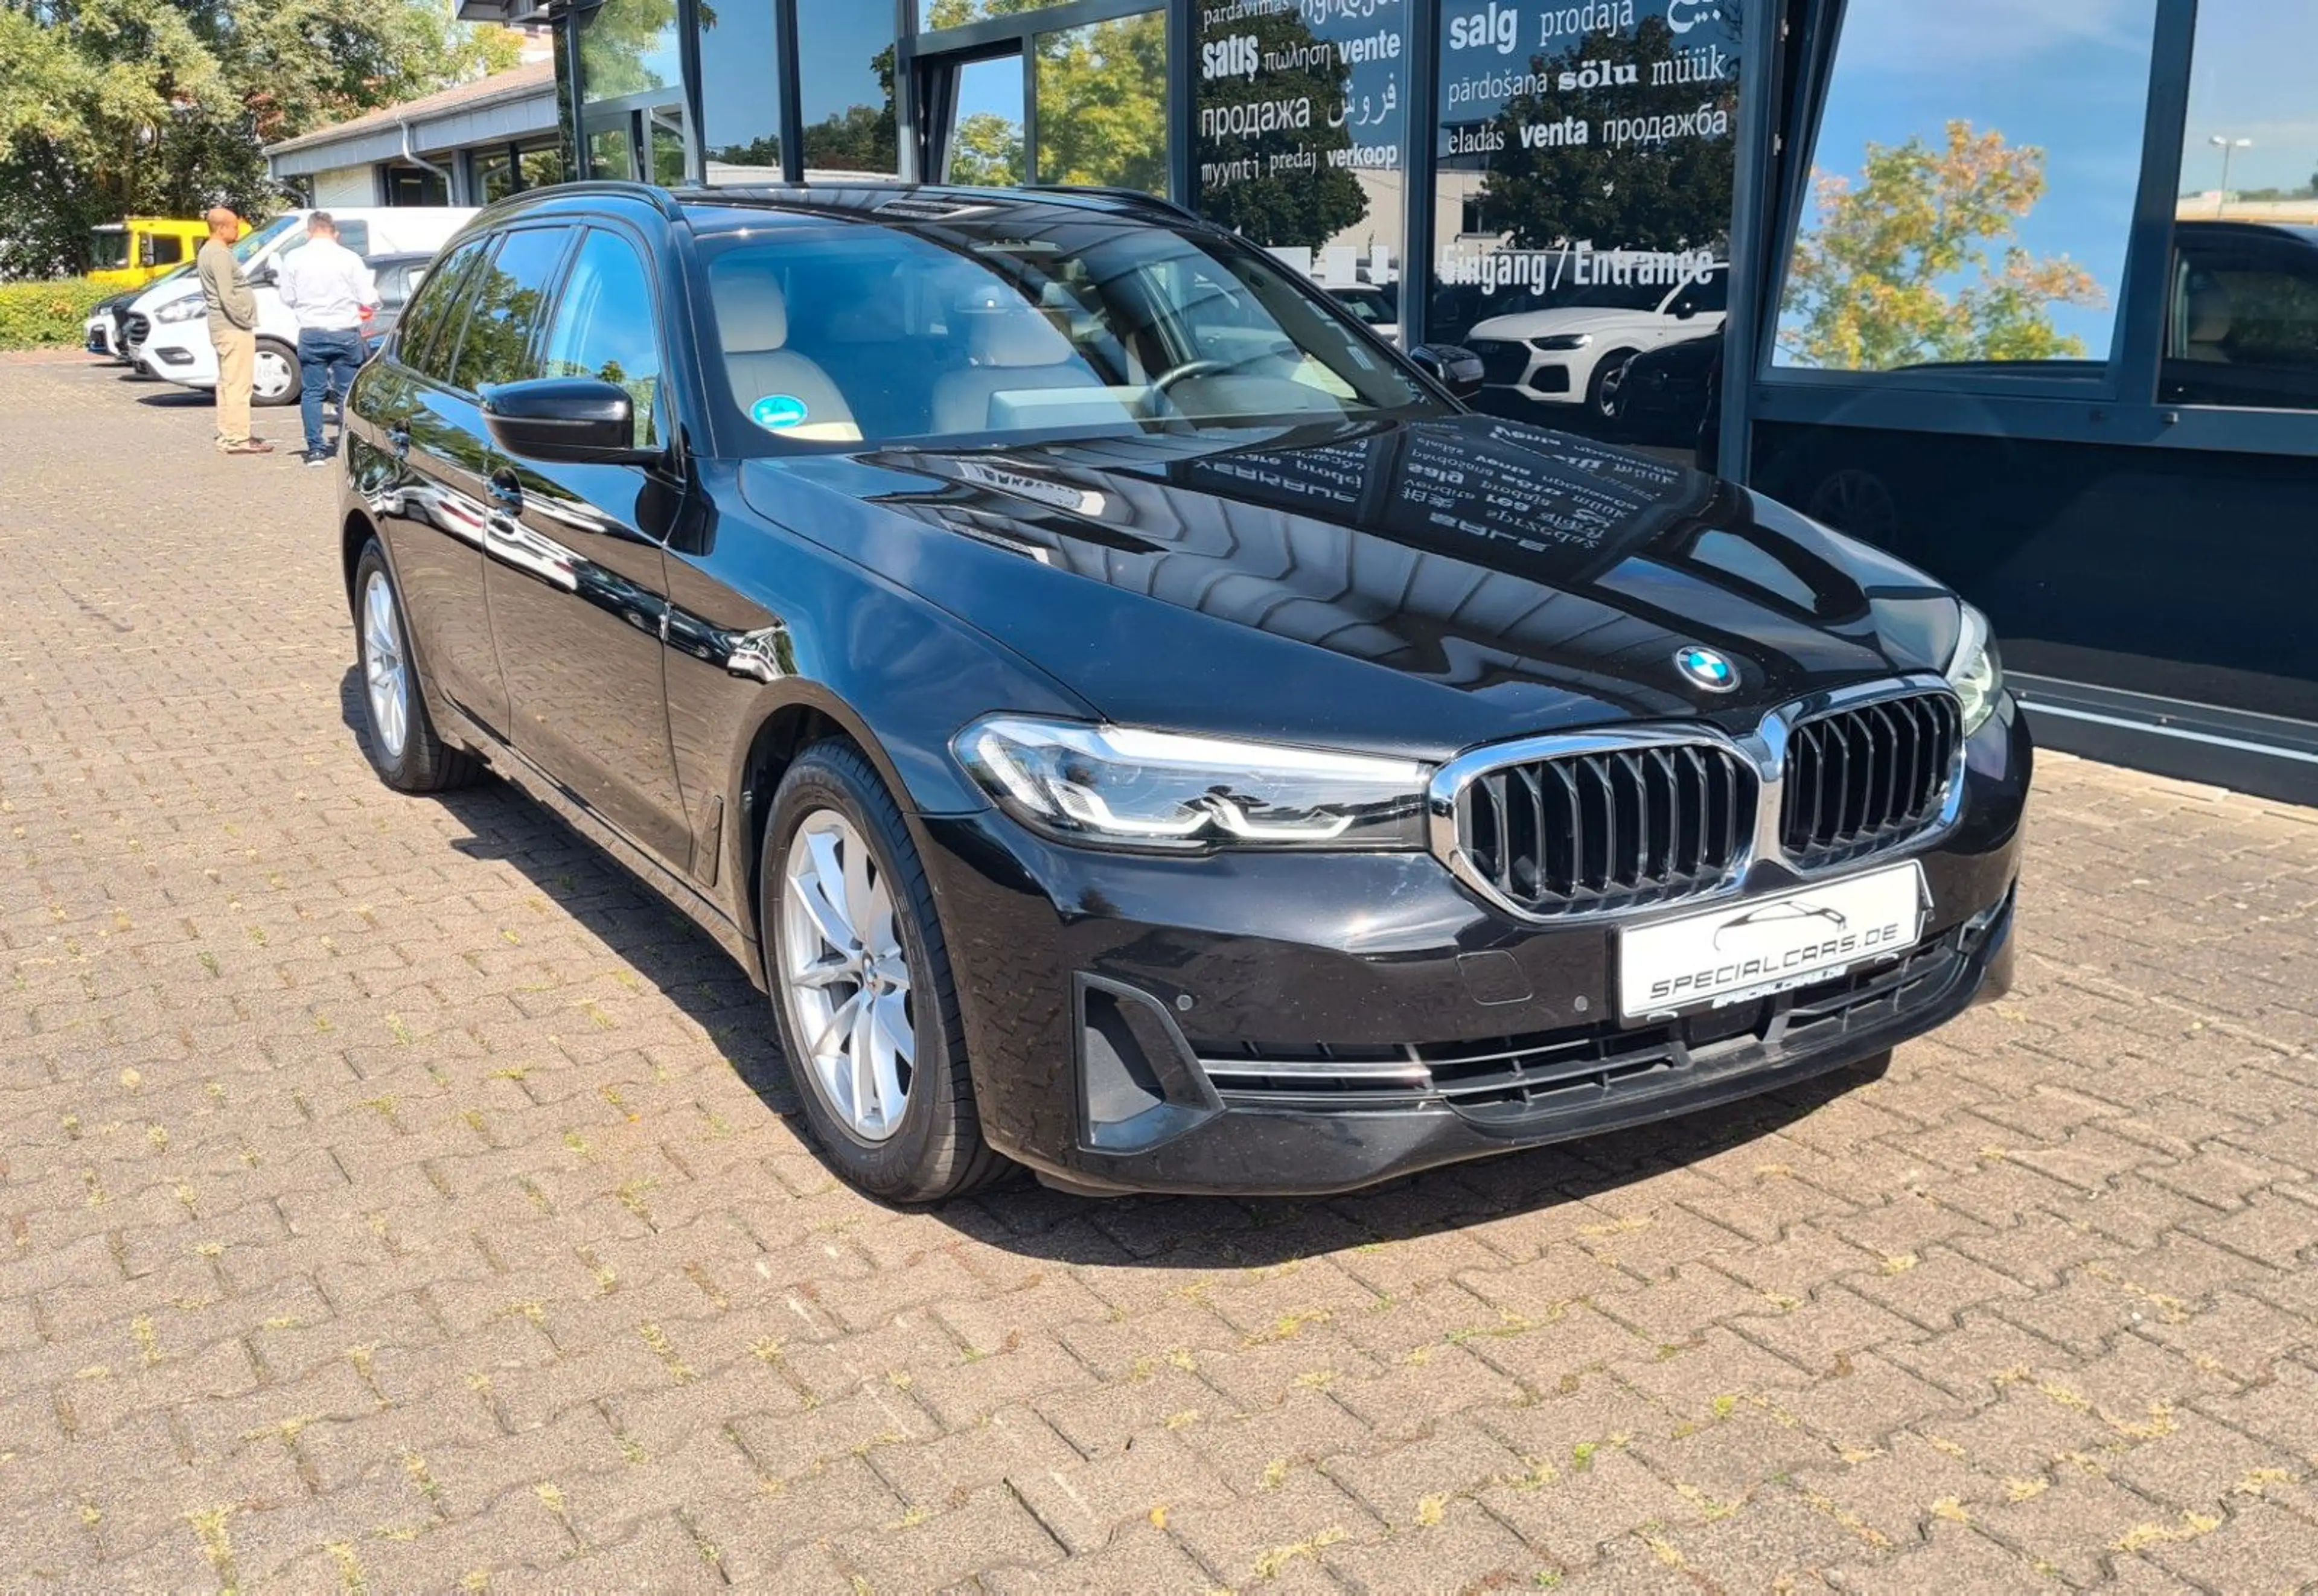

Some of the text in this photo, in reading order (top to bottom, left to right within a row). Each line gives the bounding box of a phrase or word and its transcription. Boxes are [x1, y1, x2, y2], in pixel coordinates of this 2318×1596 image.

[1338, 30, 1400, 65] vente
[1449, 0, 1518, 54] salg
[1539, 0, 1635, 47] prodaja
[1202, 34, 1259, 83] satış
[1448, 44, 1727, 110] pārdošana sölu müük
[1201, 97, 1311, 146] продажа
[1449, 117, 1588, 155] eladás venta
[1603, 103, 1728, 149] продажба
[1201, 142, 1397, 188] myynti predaj verkoop
[1441, 244, 1547, 296] Eingang
[1574, 240, 1714, 286] Entrance
[1649, 924, 1899, 999] SPECIALCARS.DE
